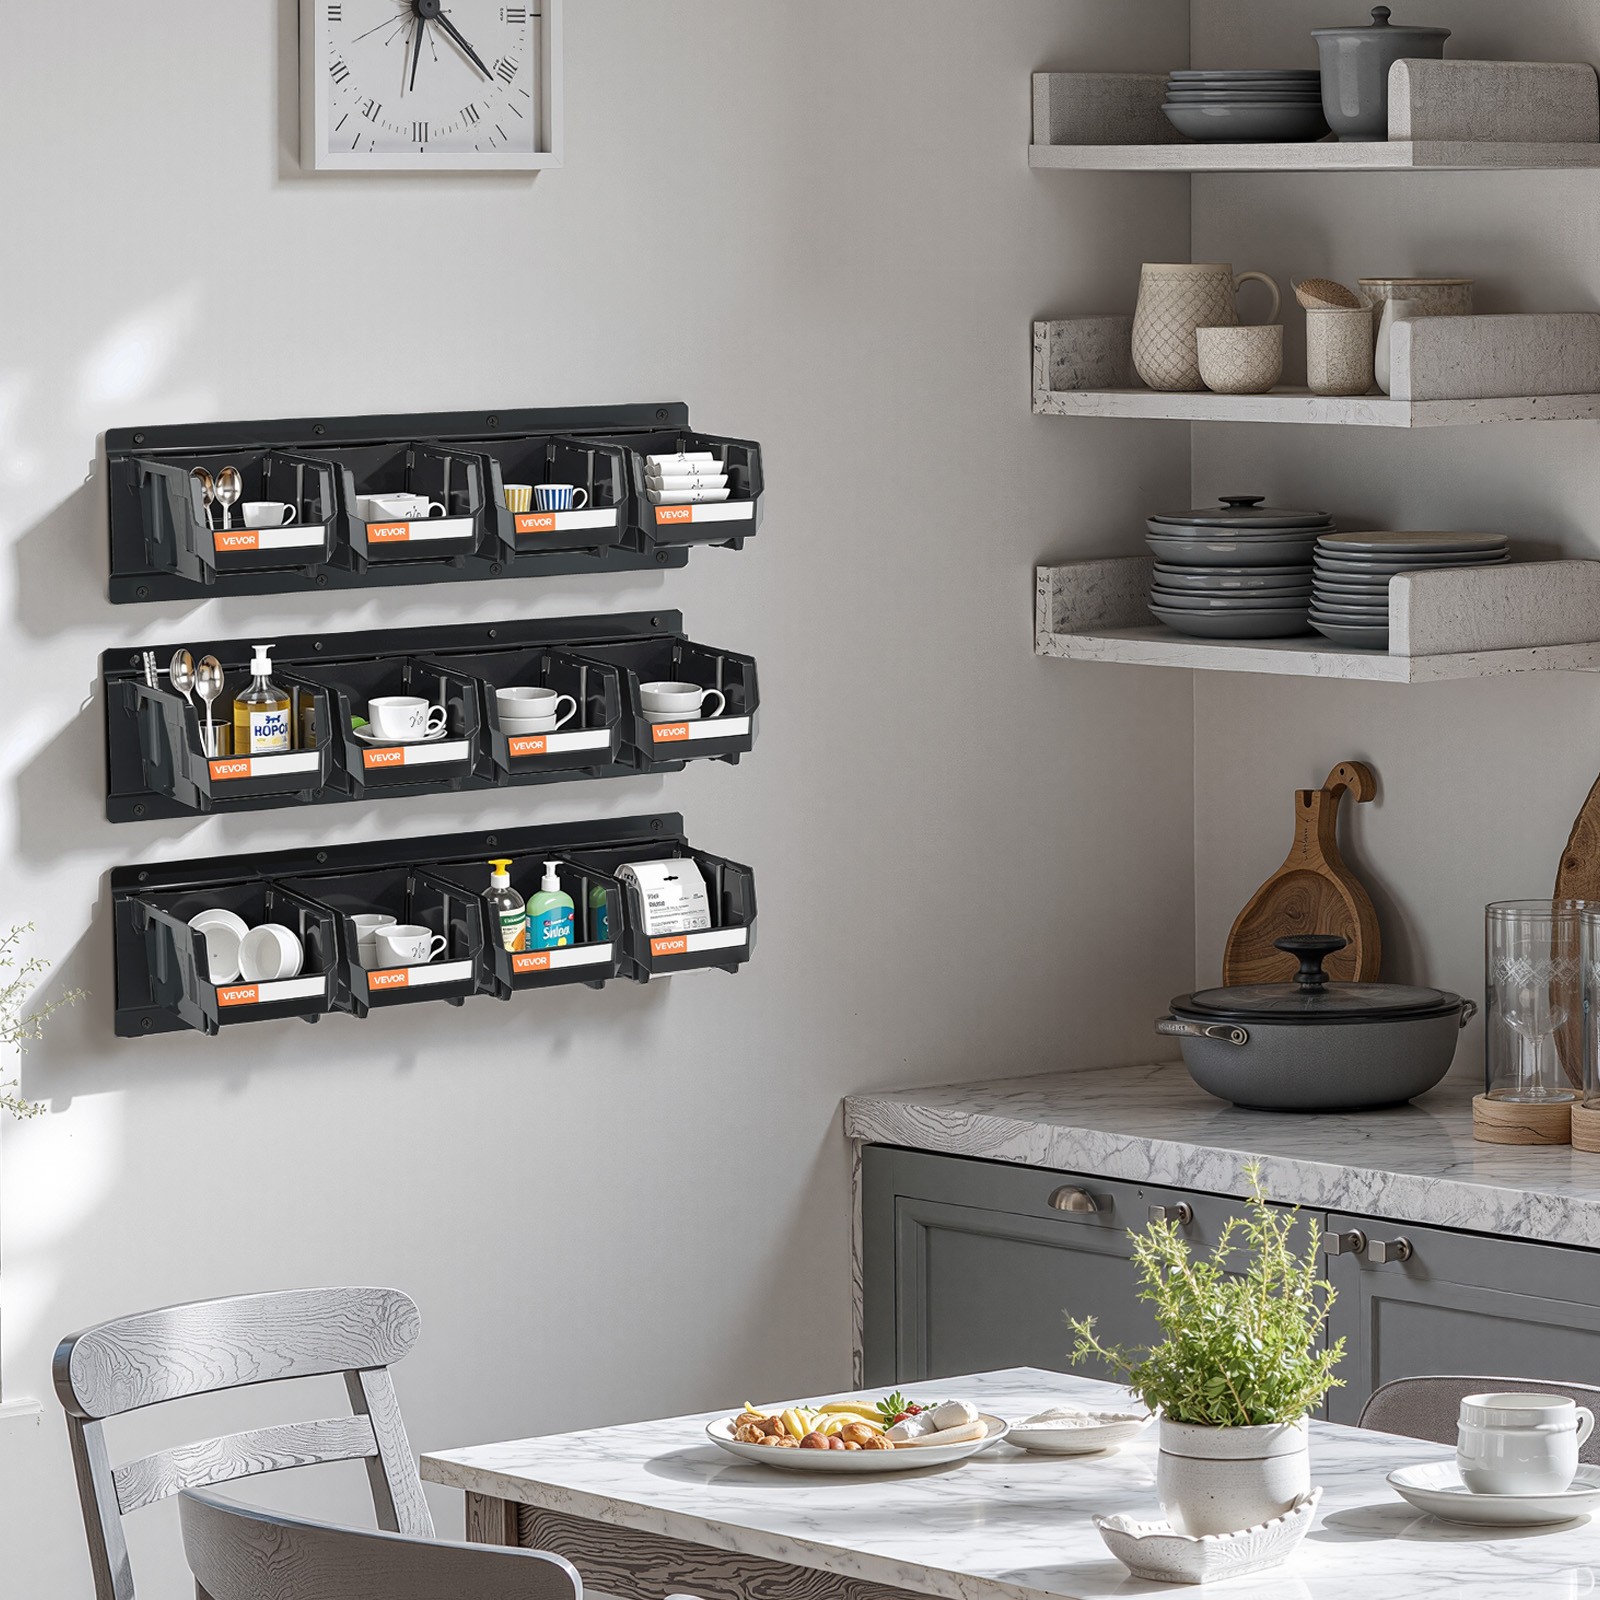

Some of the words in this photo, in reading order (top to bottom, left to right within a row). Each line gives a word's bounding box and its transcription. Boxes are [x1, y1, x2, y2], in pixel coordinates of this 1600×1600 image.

[659, 509, 690, 519] VEVOR
[520, 517, 553, 528] VEVOR
[373, 527, 406, 537] VEVOR
[222, 535, 256, 546] VEVOR
[656, 727, 687, 737] VEVOR
[513, 740, 544, 751] VEVOR
[369, 751, 401, 763] VEVOR
[214, 763, 248, 774] VEVOR
[655, 939, 685, 951] VEVOR
[516, 956, 548, 968] VEVOR
[373, 973, 406, 985] VEVOR
[222, 989, 256, 1001] VEVOR
